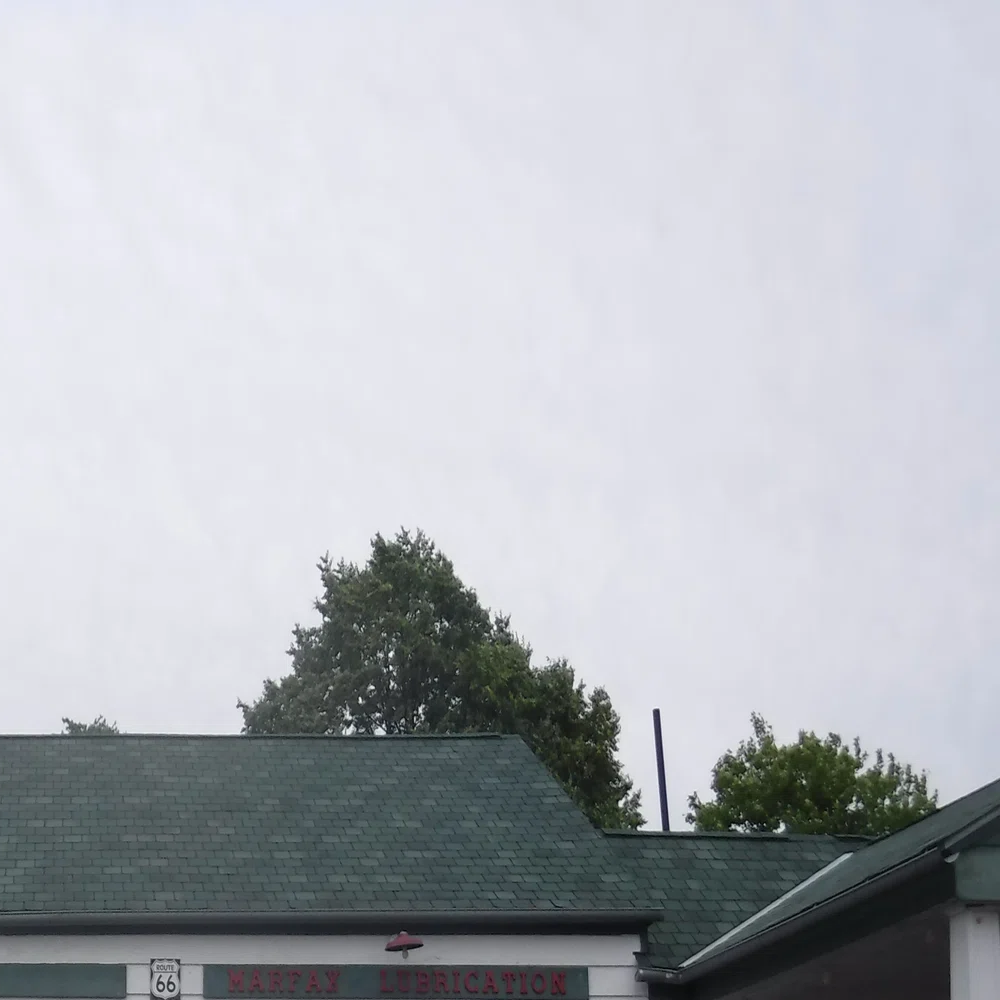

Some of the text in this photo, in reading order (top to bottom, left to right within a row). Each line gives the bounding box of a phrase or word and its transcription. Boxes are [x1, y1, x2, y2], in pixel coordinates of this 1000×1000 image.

[156, 974, 176, 993] 66
[228, 969, 566, 995] MARFAX LUBRICATION
